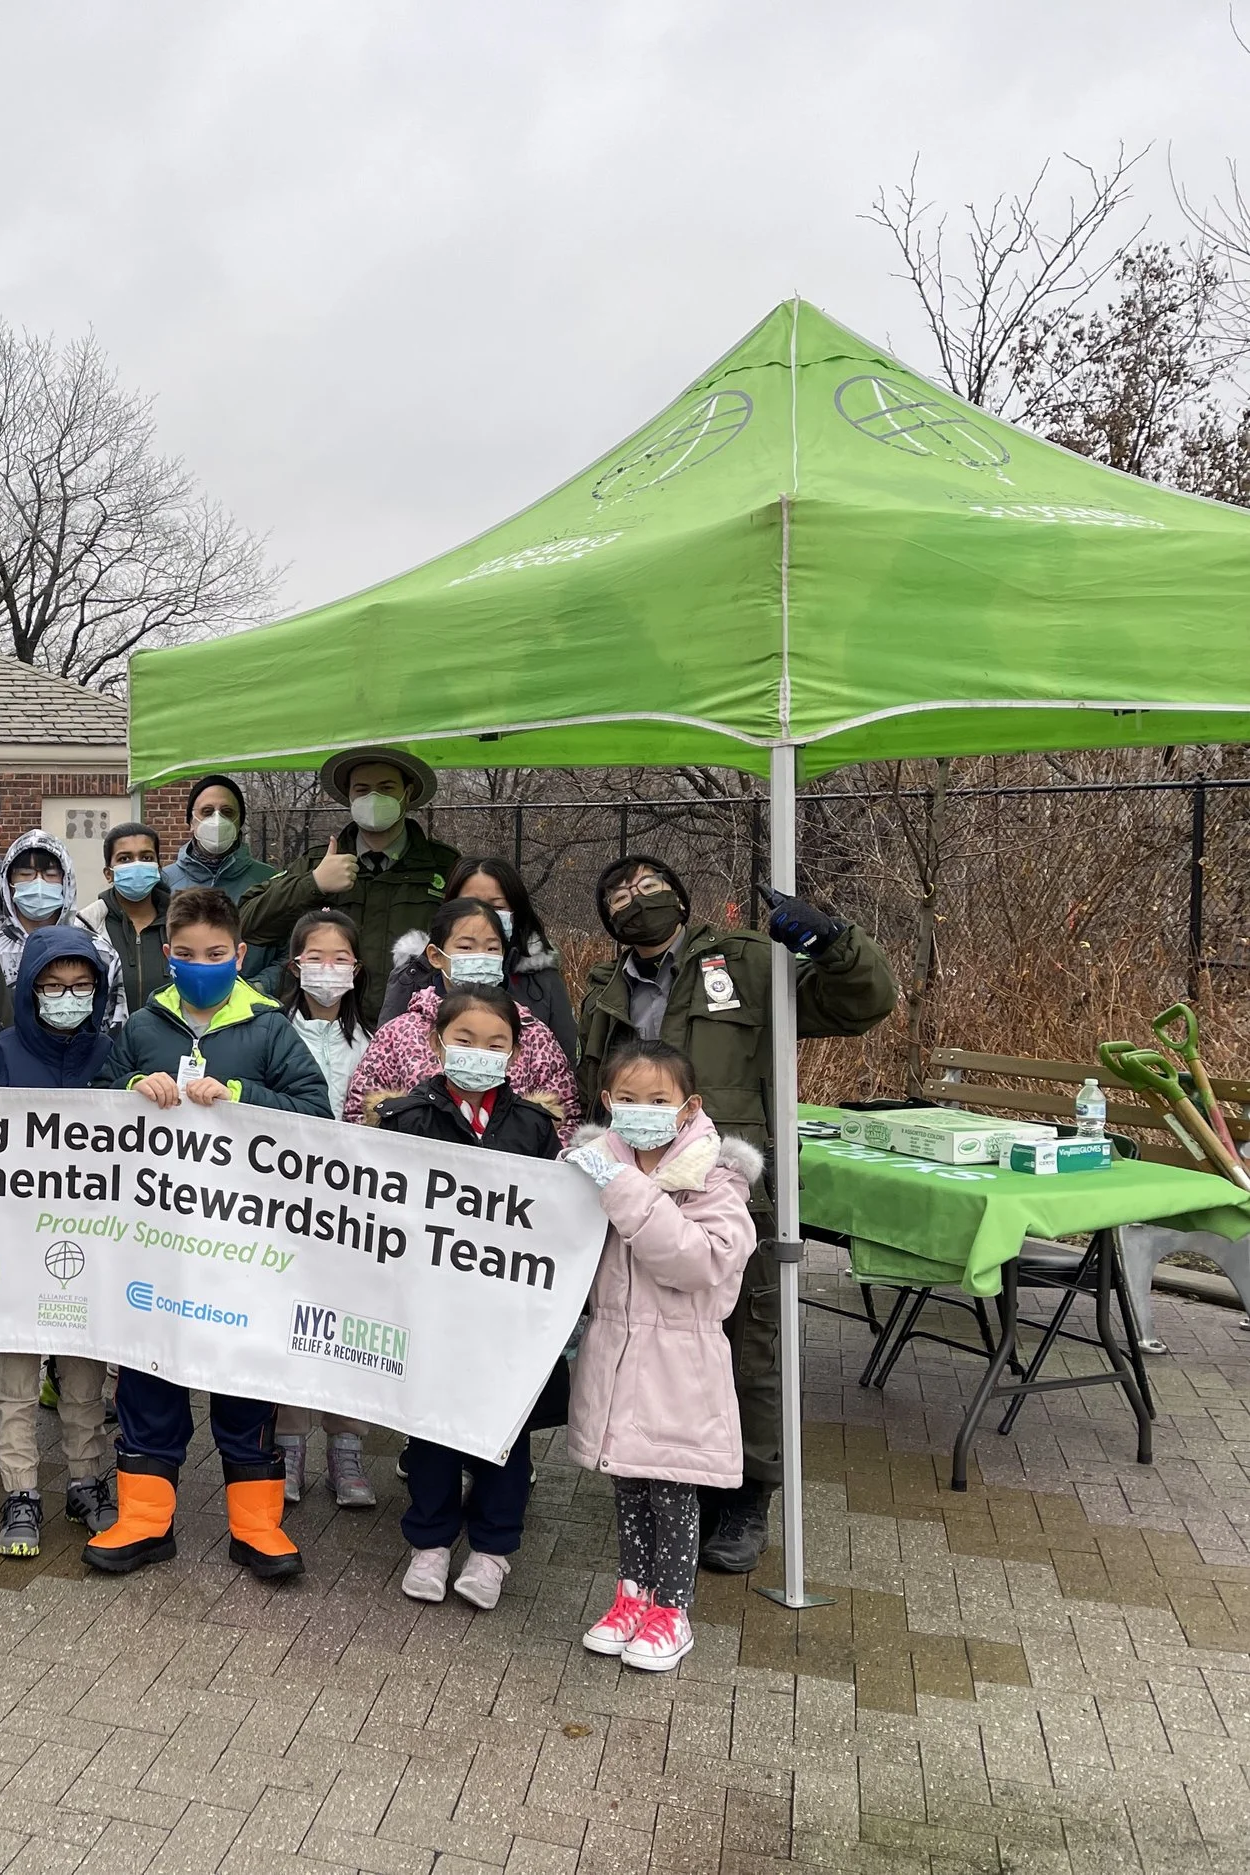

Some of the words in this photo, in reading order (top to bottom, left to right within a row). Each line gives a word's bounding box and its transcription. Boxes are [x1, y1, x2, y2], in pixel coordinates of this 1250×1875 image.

[1080, 1144, 1102, 1154] GLOVES
[26, 1112, 233, 1166] Meadows
[248, 1134, 408, 1205] Corona
[425, 1168, 536, 1230] Park
[35, 1212, 129, 1242] Proudly
[133, 1220, 258, 1264] Sponsored
[260, 1244, 295, 1274] by
[134, 1167, 407, 1264] Stewardship
[424, 1224, 556, 1291] Team
[38, 1293, 73, 1301] ALLIANCE
[73, 1295, 88, 1303] FOR
[38, 1303, 88, 1314] FLUSHING
[156, 1295, 249, 1328] conEdison
[37, 1312, 87, 1323] MEADOWS
[37, 1320, 68, 1329] CORONA
[68, 1321, 87, 1330] PARK
[293, 1304, 337, 1341] NYC
[341, 1315, 407, 1362] GREEN
[291, 1336, 322, 1354] RELIEF
[324, 1345, 332, 1356] &
[333, 1344, 380, 1368] RECOVERY
[380, 1356, 404, 1376] FUND
